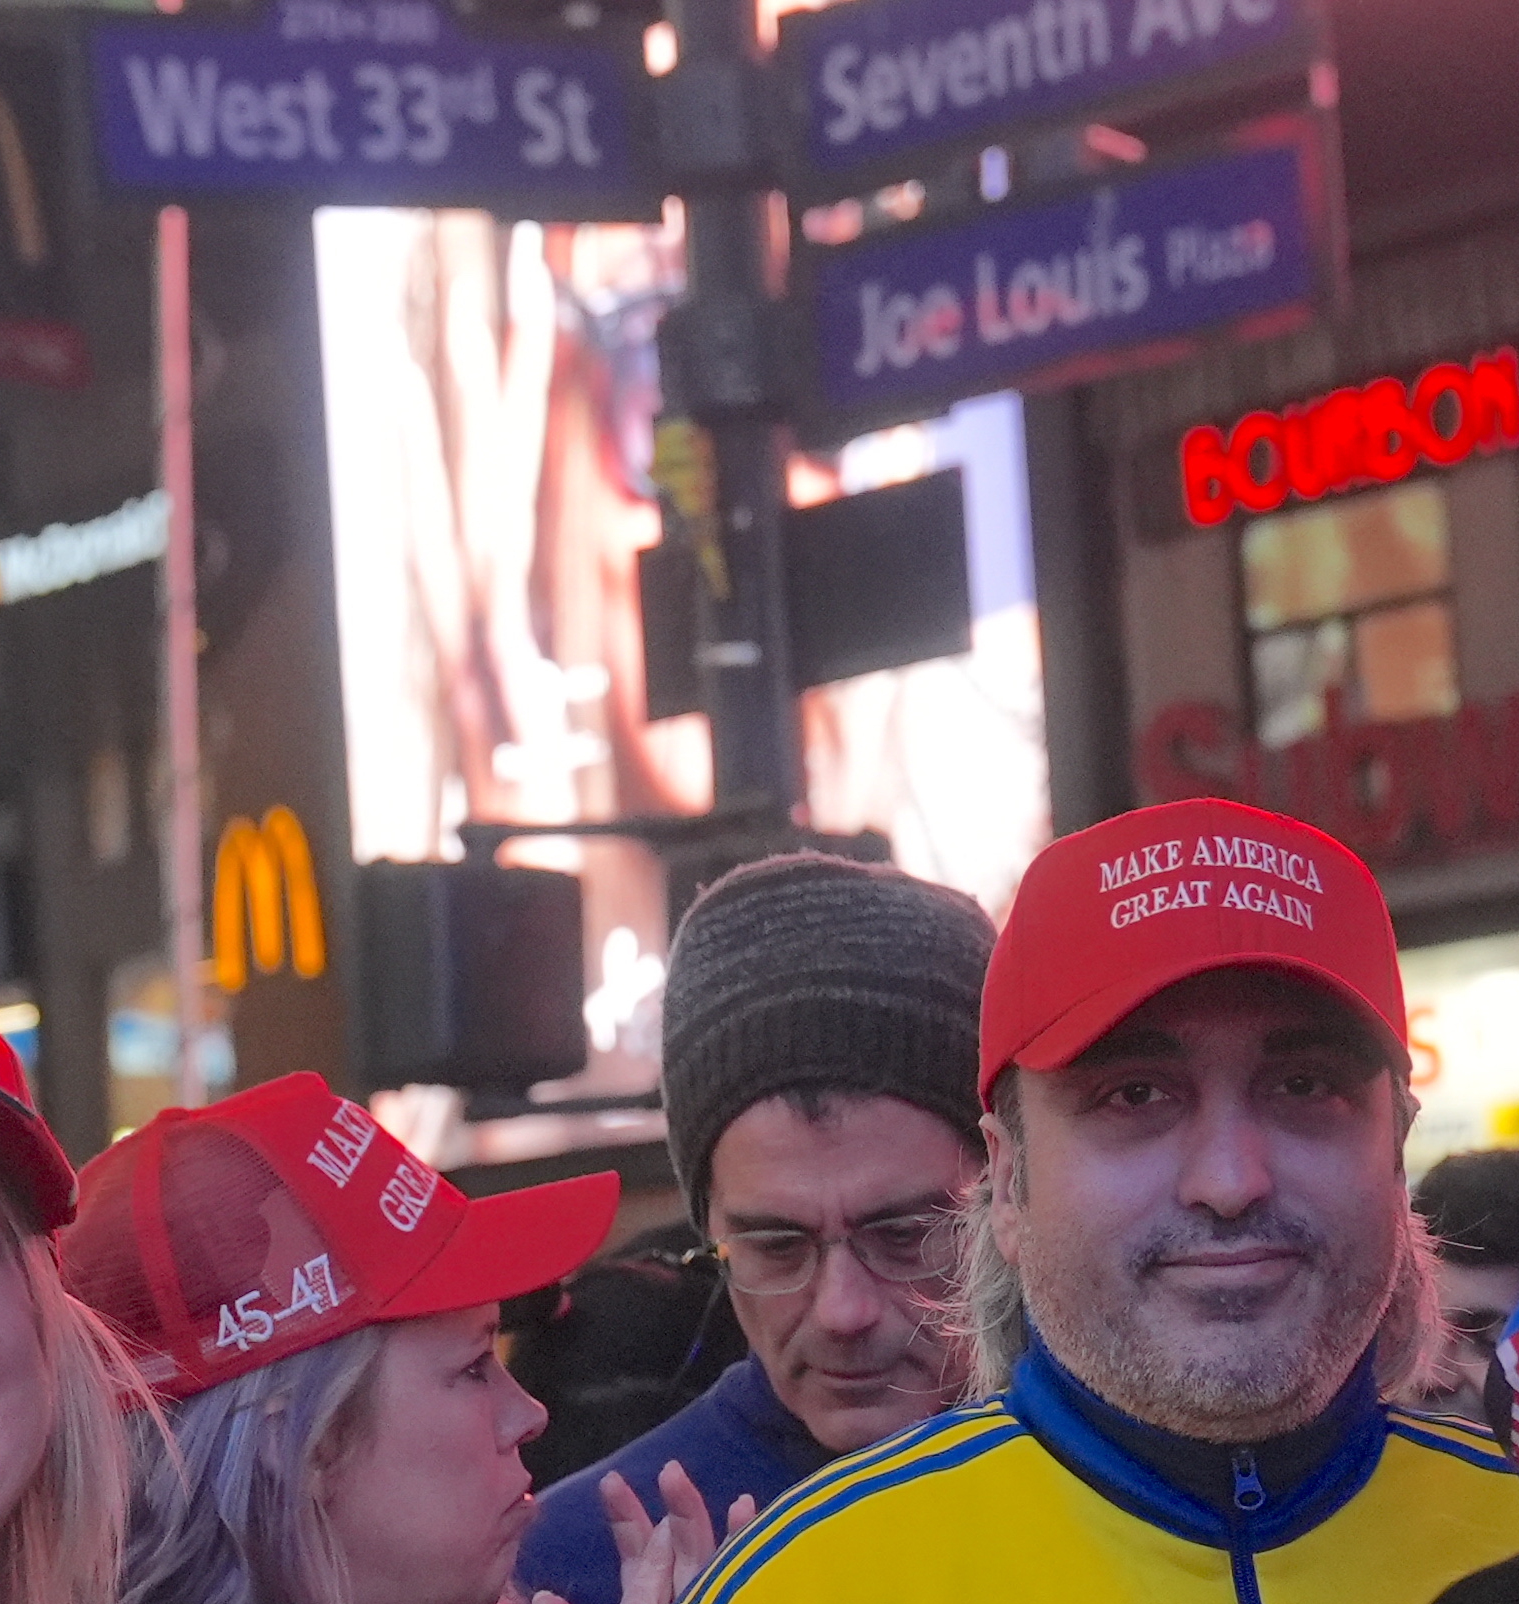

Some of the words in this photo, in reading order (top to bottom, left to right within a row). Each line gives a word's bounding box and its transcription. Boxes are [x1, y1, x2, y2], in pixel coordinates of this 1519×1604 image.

[123, 56, 342, 161] West
[352, 62, 496, 164] 33rd
[512, 67, 602, 166] St
[822, 0, 1110, 143] Seventh
[854, 283, 963, 377] Joe
[976, 232, 1150, 346] Louis
[1165, 220, 1275, 286] Plaza
[1099, 840, 1182, 893] MAKE
[1192, 836, 1323, 895] AMERICA
[1110, 881, 1211, 930] GREAT
[1222, 881, 1314, 931] AGAIN
[215, 1253, 340, 1351] 45-47
